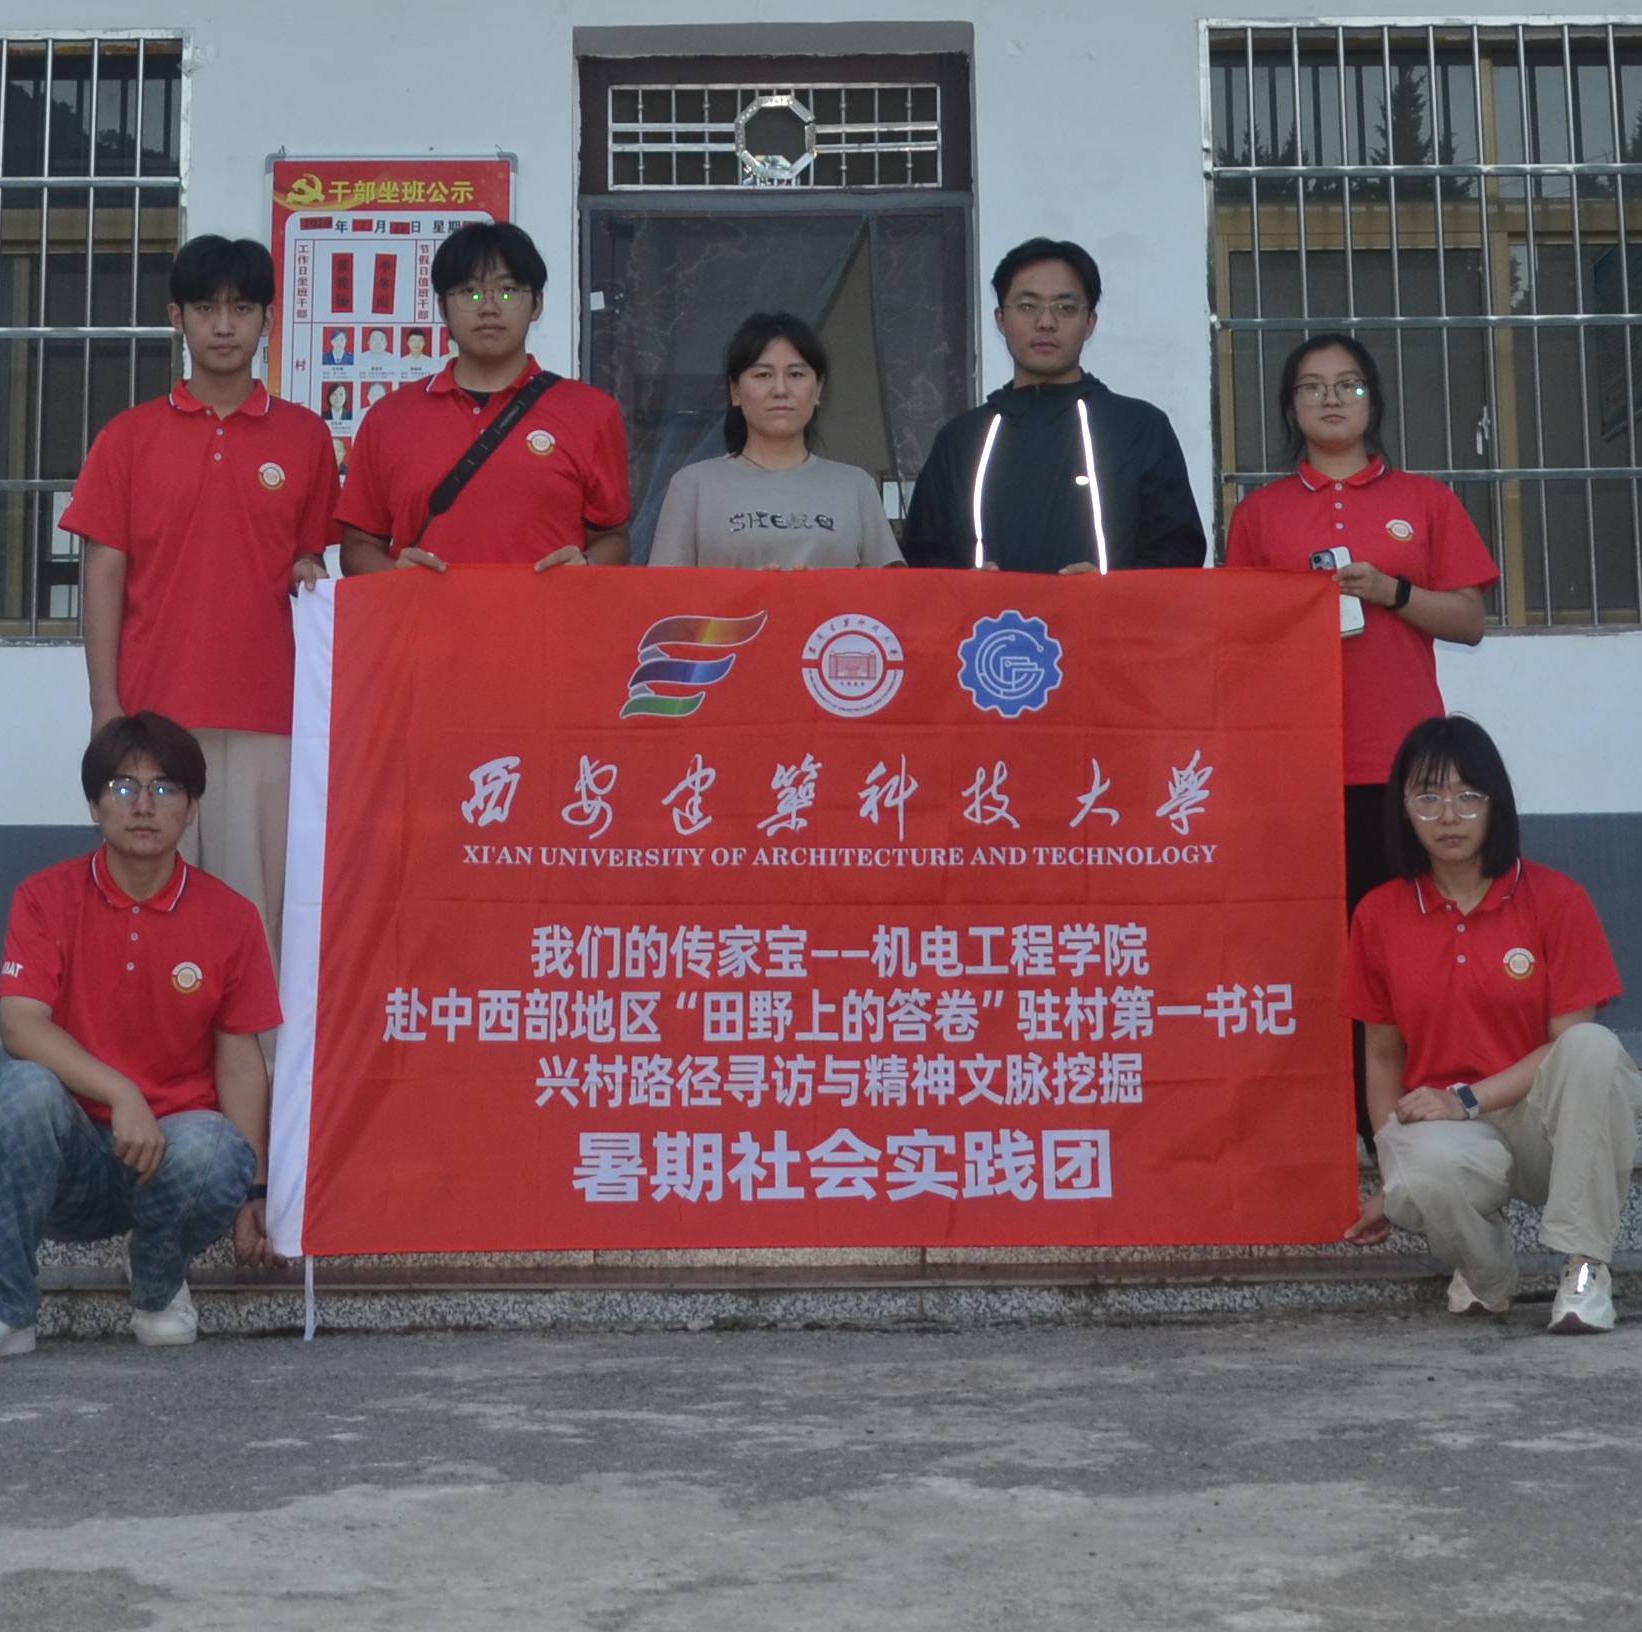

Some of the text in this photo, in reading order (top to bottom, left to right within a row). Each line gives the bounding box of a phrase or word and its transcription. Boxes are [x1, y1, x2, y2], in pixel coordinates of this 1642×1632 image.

[328, 180, 475, 205] 干部坐班公示
[334, 220, 348, 234] 年
[374, 220, 386, 234] 月
[411, 220, 421, 234] 日
[296, 244, 309, 319] 工作日坐班干部
[417, 244, 430, 320] 节假日值班干部
[463, 844, 1217, 868] XI'AN UNIVERSITY OF ARCHITECTURE AND TECHNOLOGY
[535, 1052, 1144, 1109] 兴村路径寻访与精神文脉挖掘
[572, 1128, 1113, 1204] 暑期社会实践团
